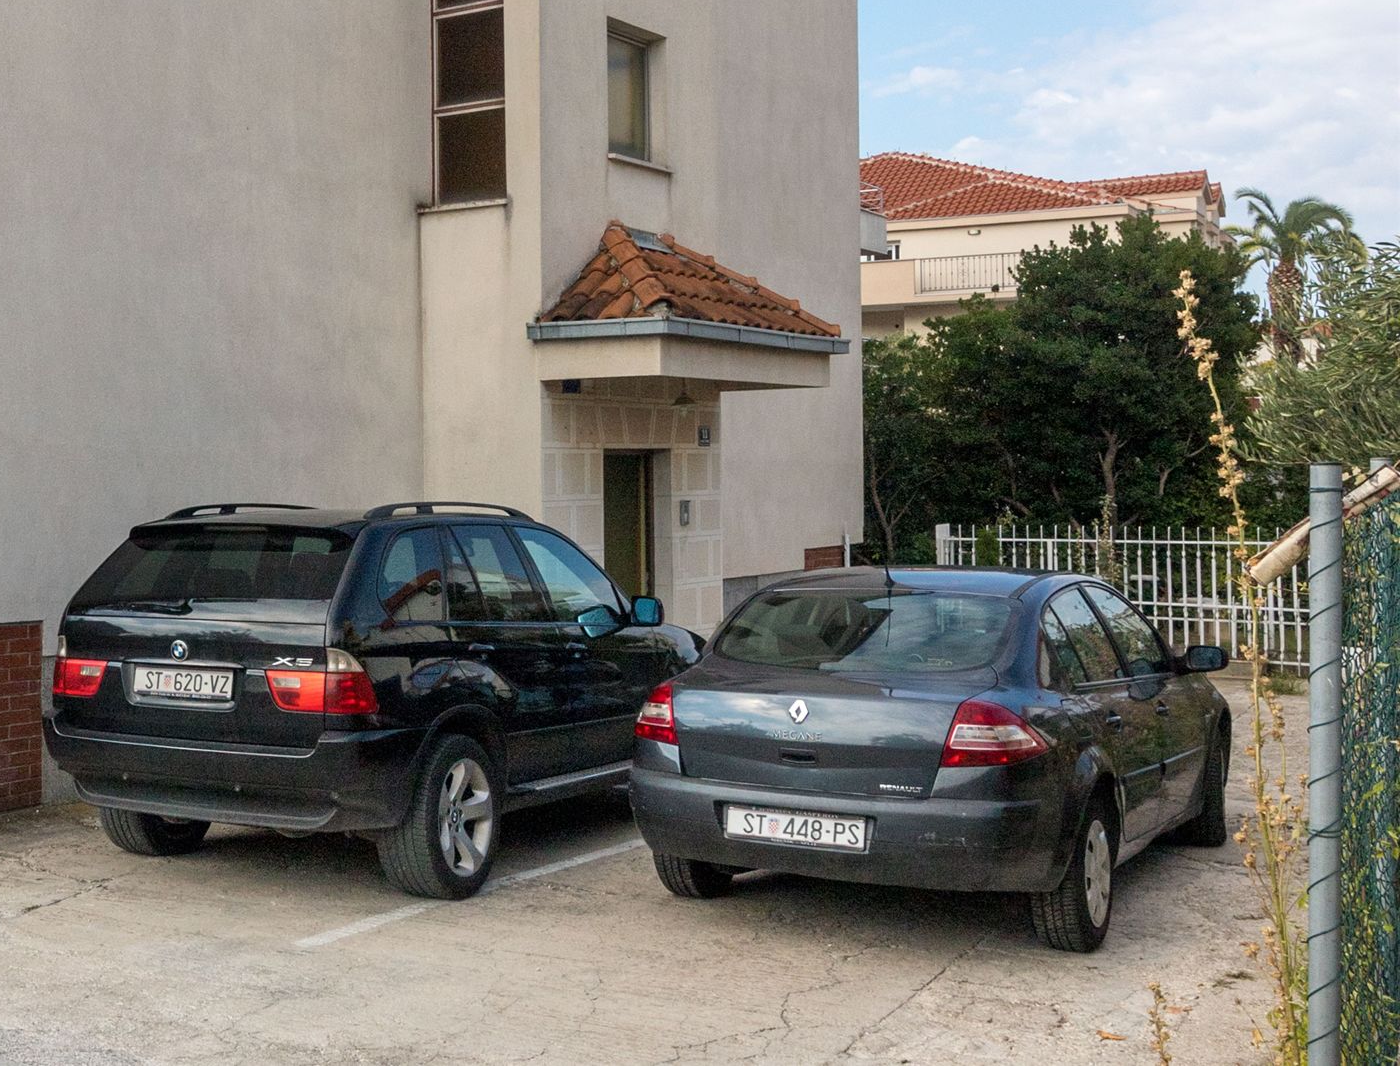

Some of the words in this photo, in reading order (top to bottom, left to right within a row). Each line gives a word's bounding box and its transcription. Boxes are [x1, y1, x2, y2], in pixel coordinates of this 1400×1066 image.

[271, 656, 313, 667] X5
[145, 671, 163, 689] ST
[173, 672, 230, 694] 620-VZ
[743, 813, 767, 834] ST
[782, 817, 860, 845] 448-PS
